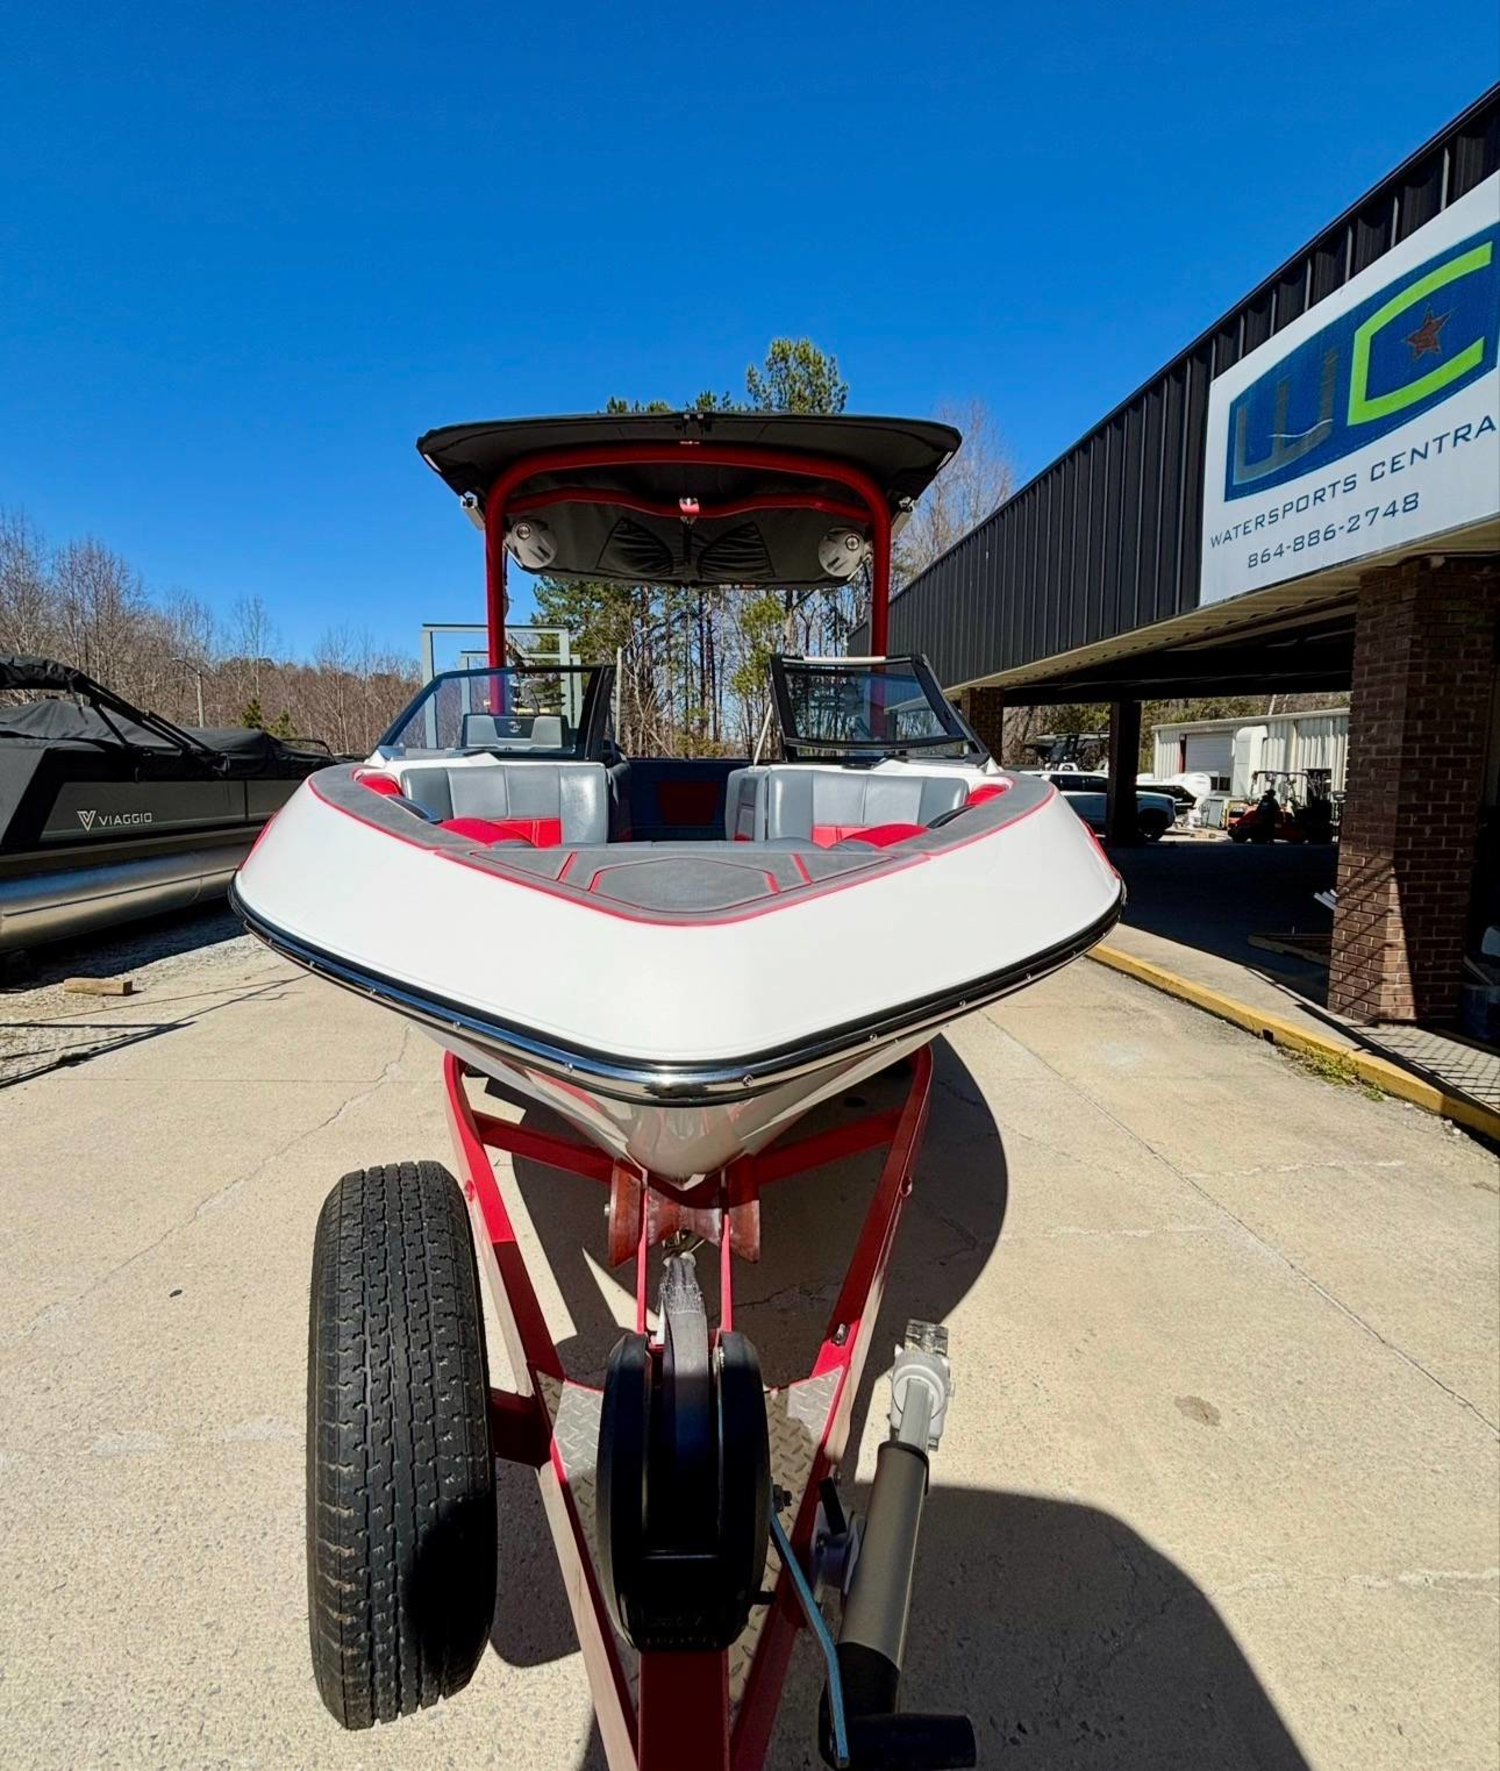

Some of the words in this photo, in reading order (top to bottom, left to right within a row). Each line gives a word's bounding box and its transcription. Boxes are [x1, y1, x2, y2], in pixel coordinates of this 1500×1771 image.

[1209, 473, 1358, 549] WATERSPORTS
[1247, 491, 1420, 568] 864-886-2748
[98, 812, 152, 826] VIAGGIO
